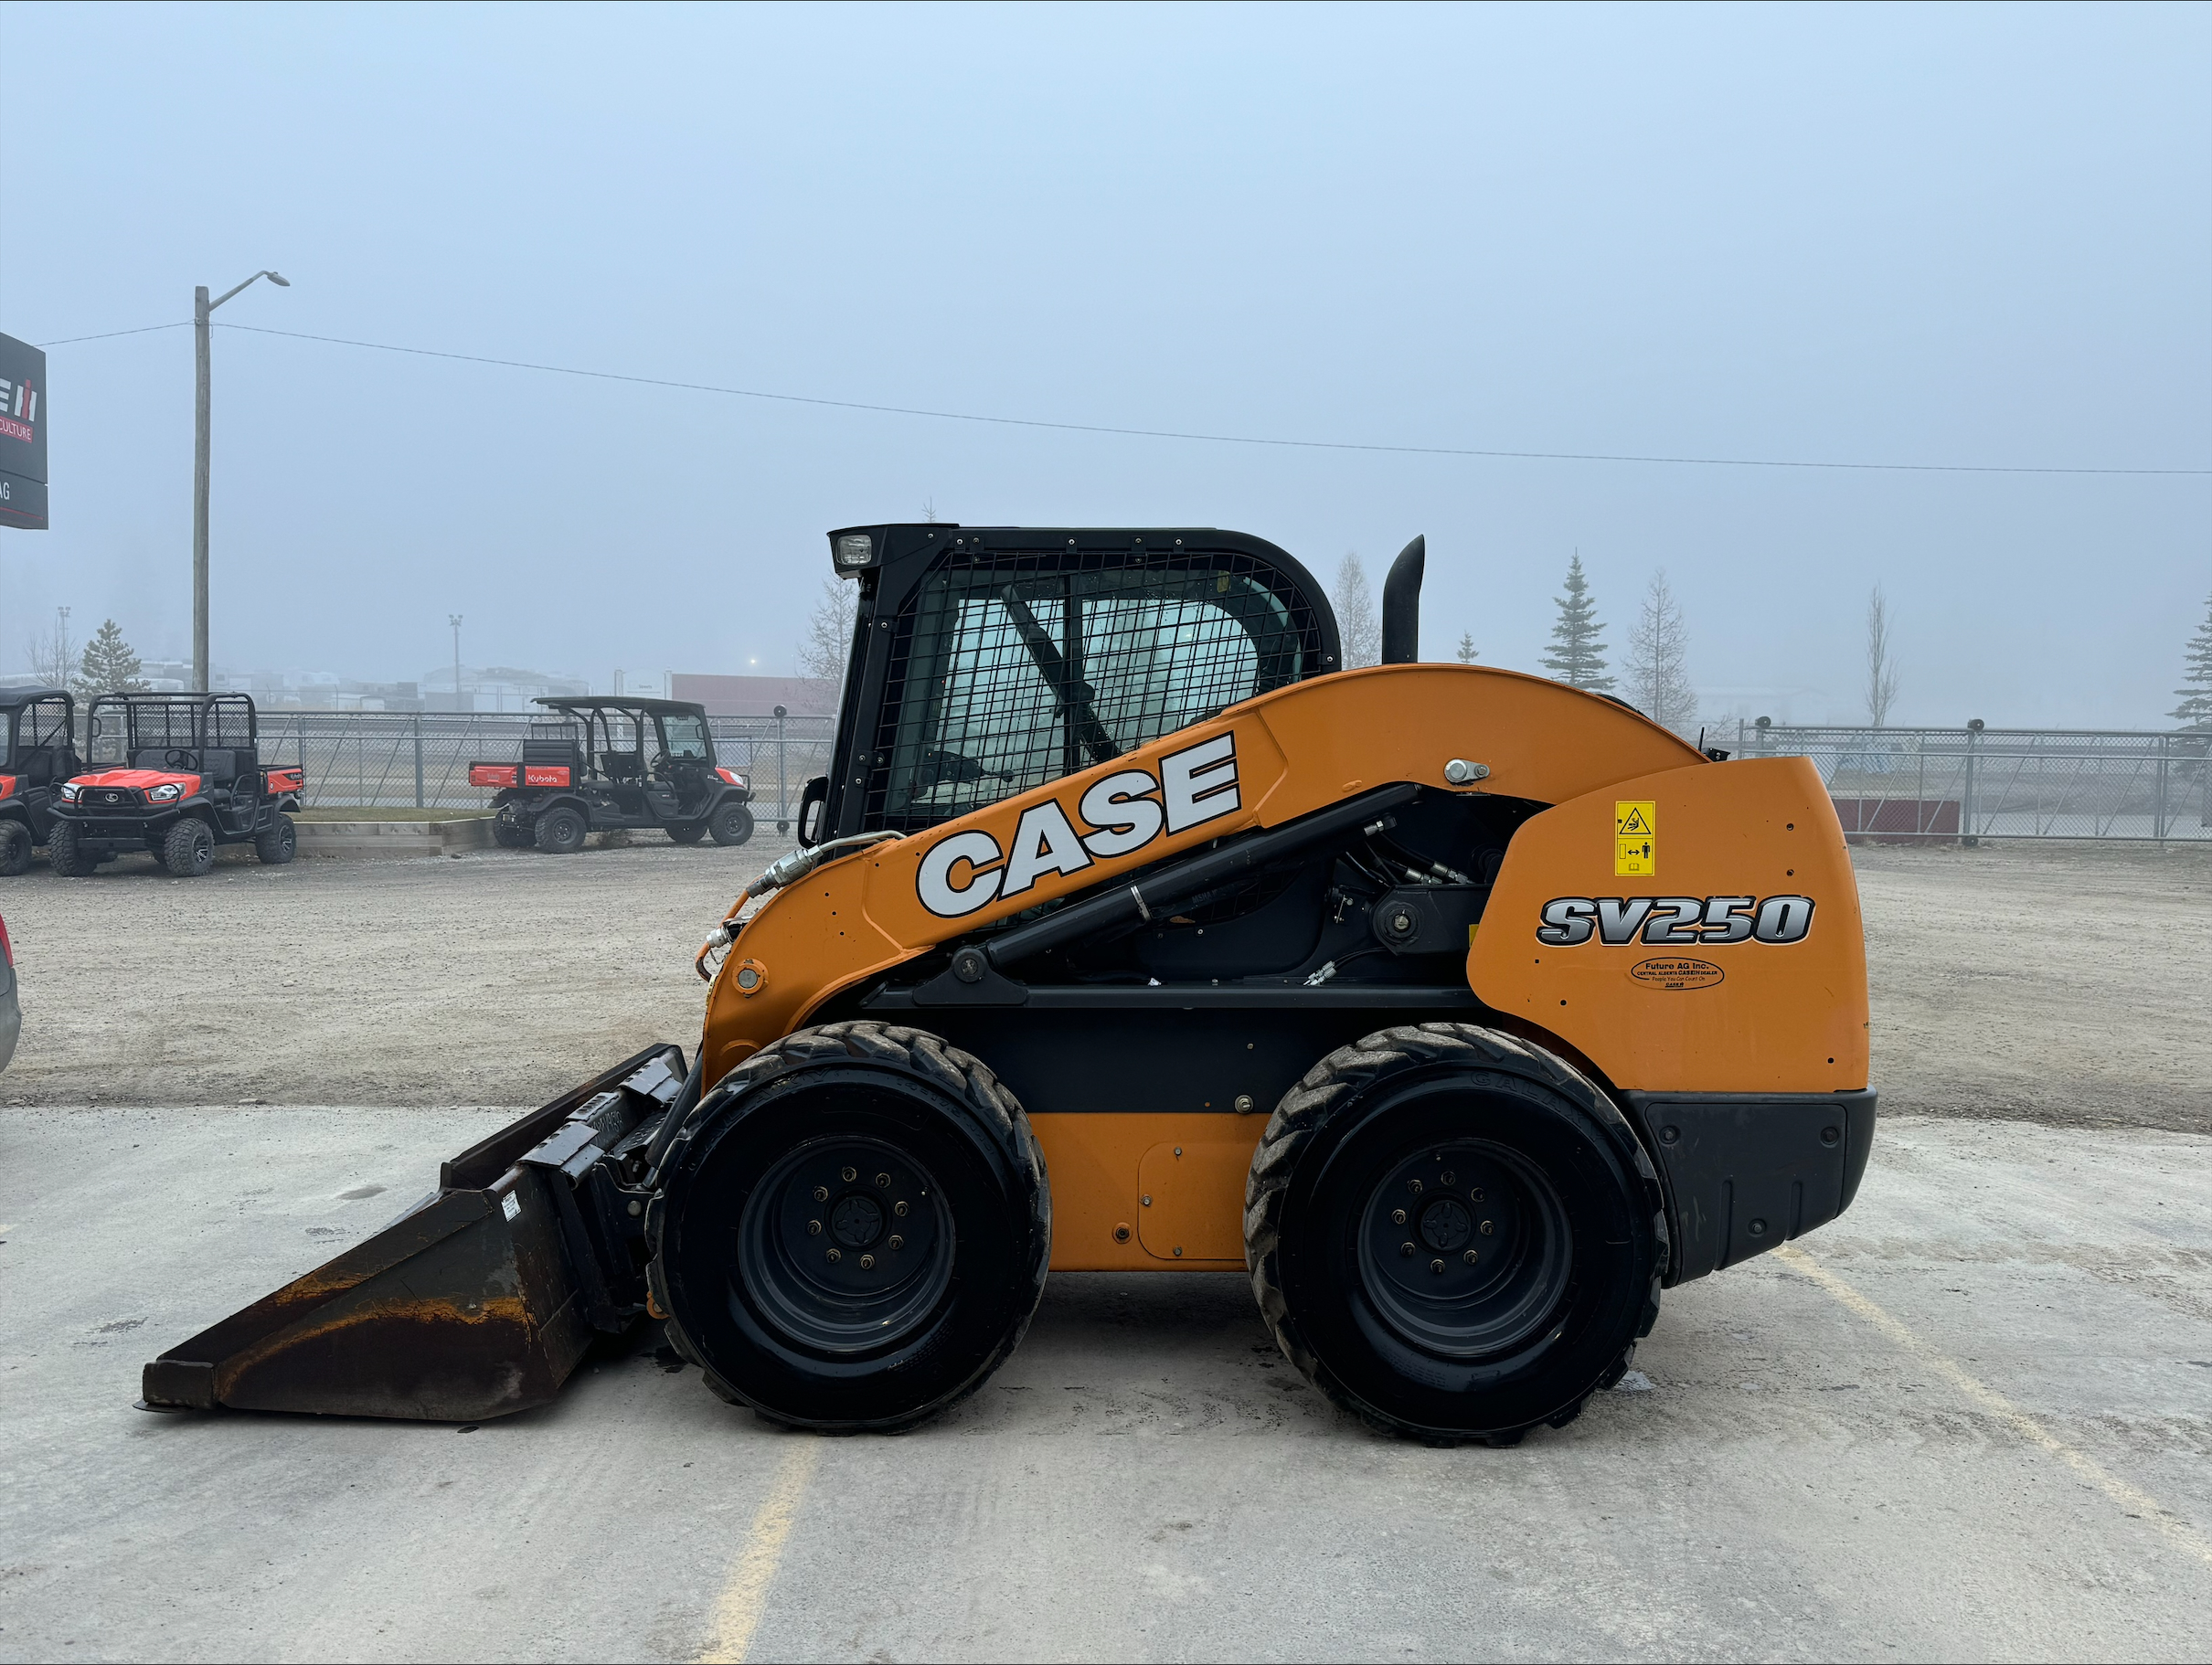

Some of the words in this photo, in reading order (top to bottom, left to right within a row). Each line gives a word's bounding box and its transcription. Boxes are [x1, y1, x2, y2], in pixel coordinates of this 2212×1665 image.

[527, 774, 558, 783] Kubota
[915, 730, 1242, 918] CASE
[1536, 895, 1815, 946] SV250
[1471, 1070, 1607, 1143] GALAXY
